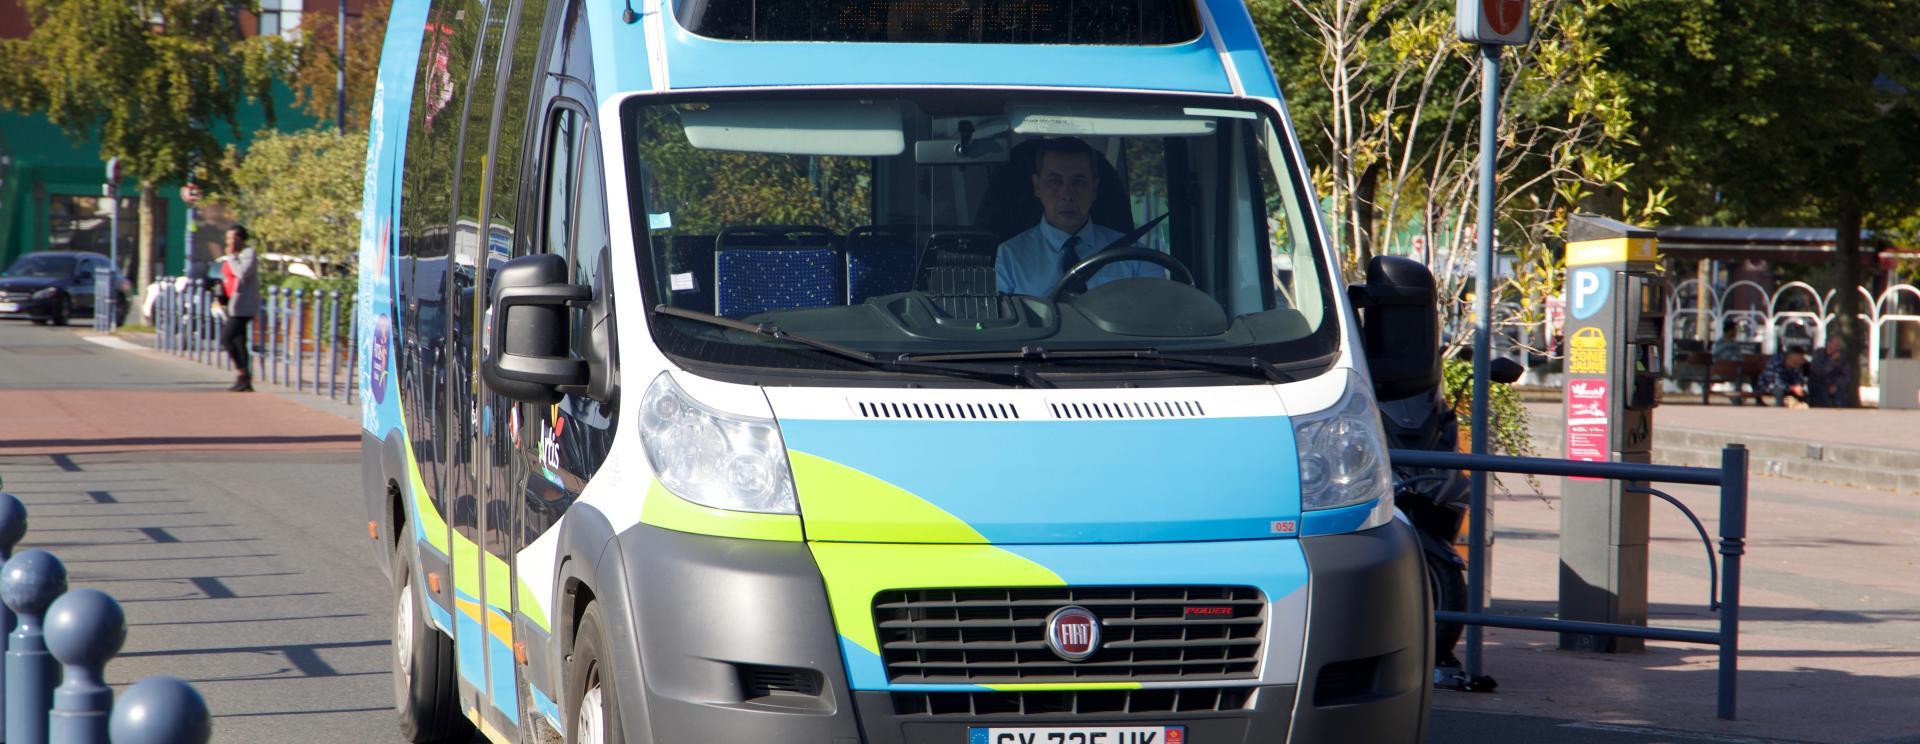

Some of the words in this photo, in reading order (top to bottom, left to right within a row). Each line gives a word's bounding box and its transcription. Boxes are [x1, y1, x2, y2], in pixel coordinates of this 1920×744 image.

[1575, 271, 1600, 309] P
[1569, 350, 1607, 361] ZONE
[1568, 361, 1607, 371] JAUNE
[1275, 521, 1295, 532] 052
[1185, 606, 1233, 616] POWER
[1061, 623, 1090, 645] FIAT
